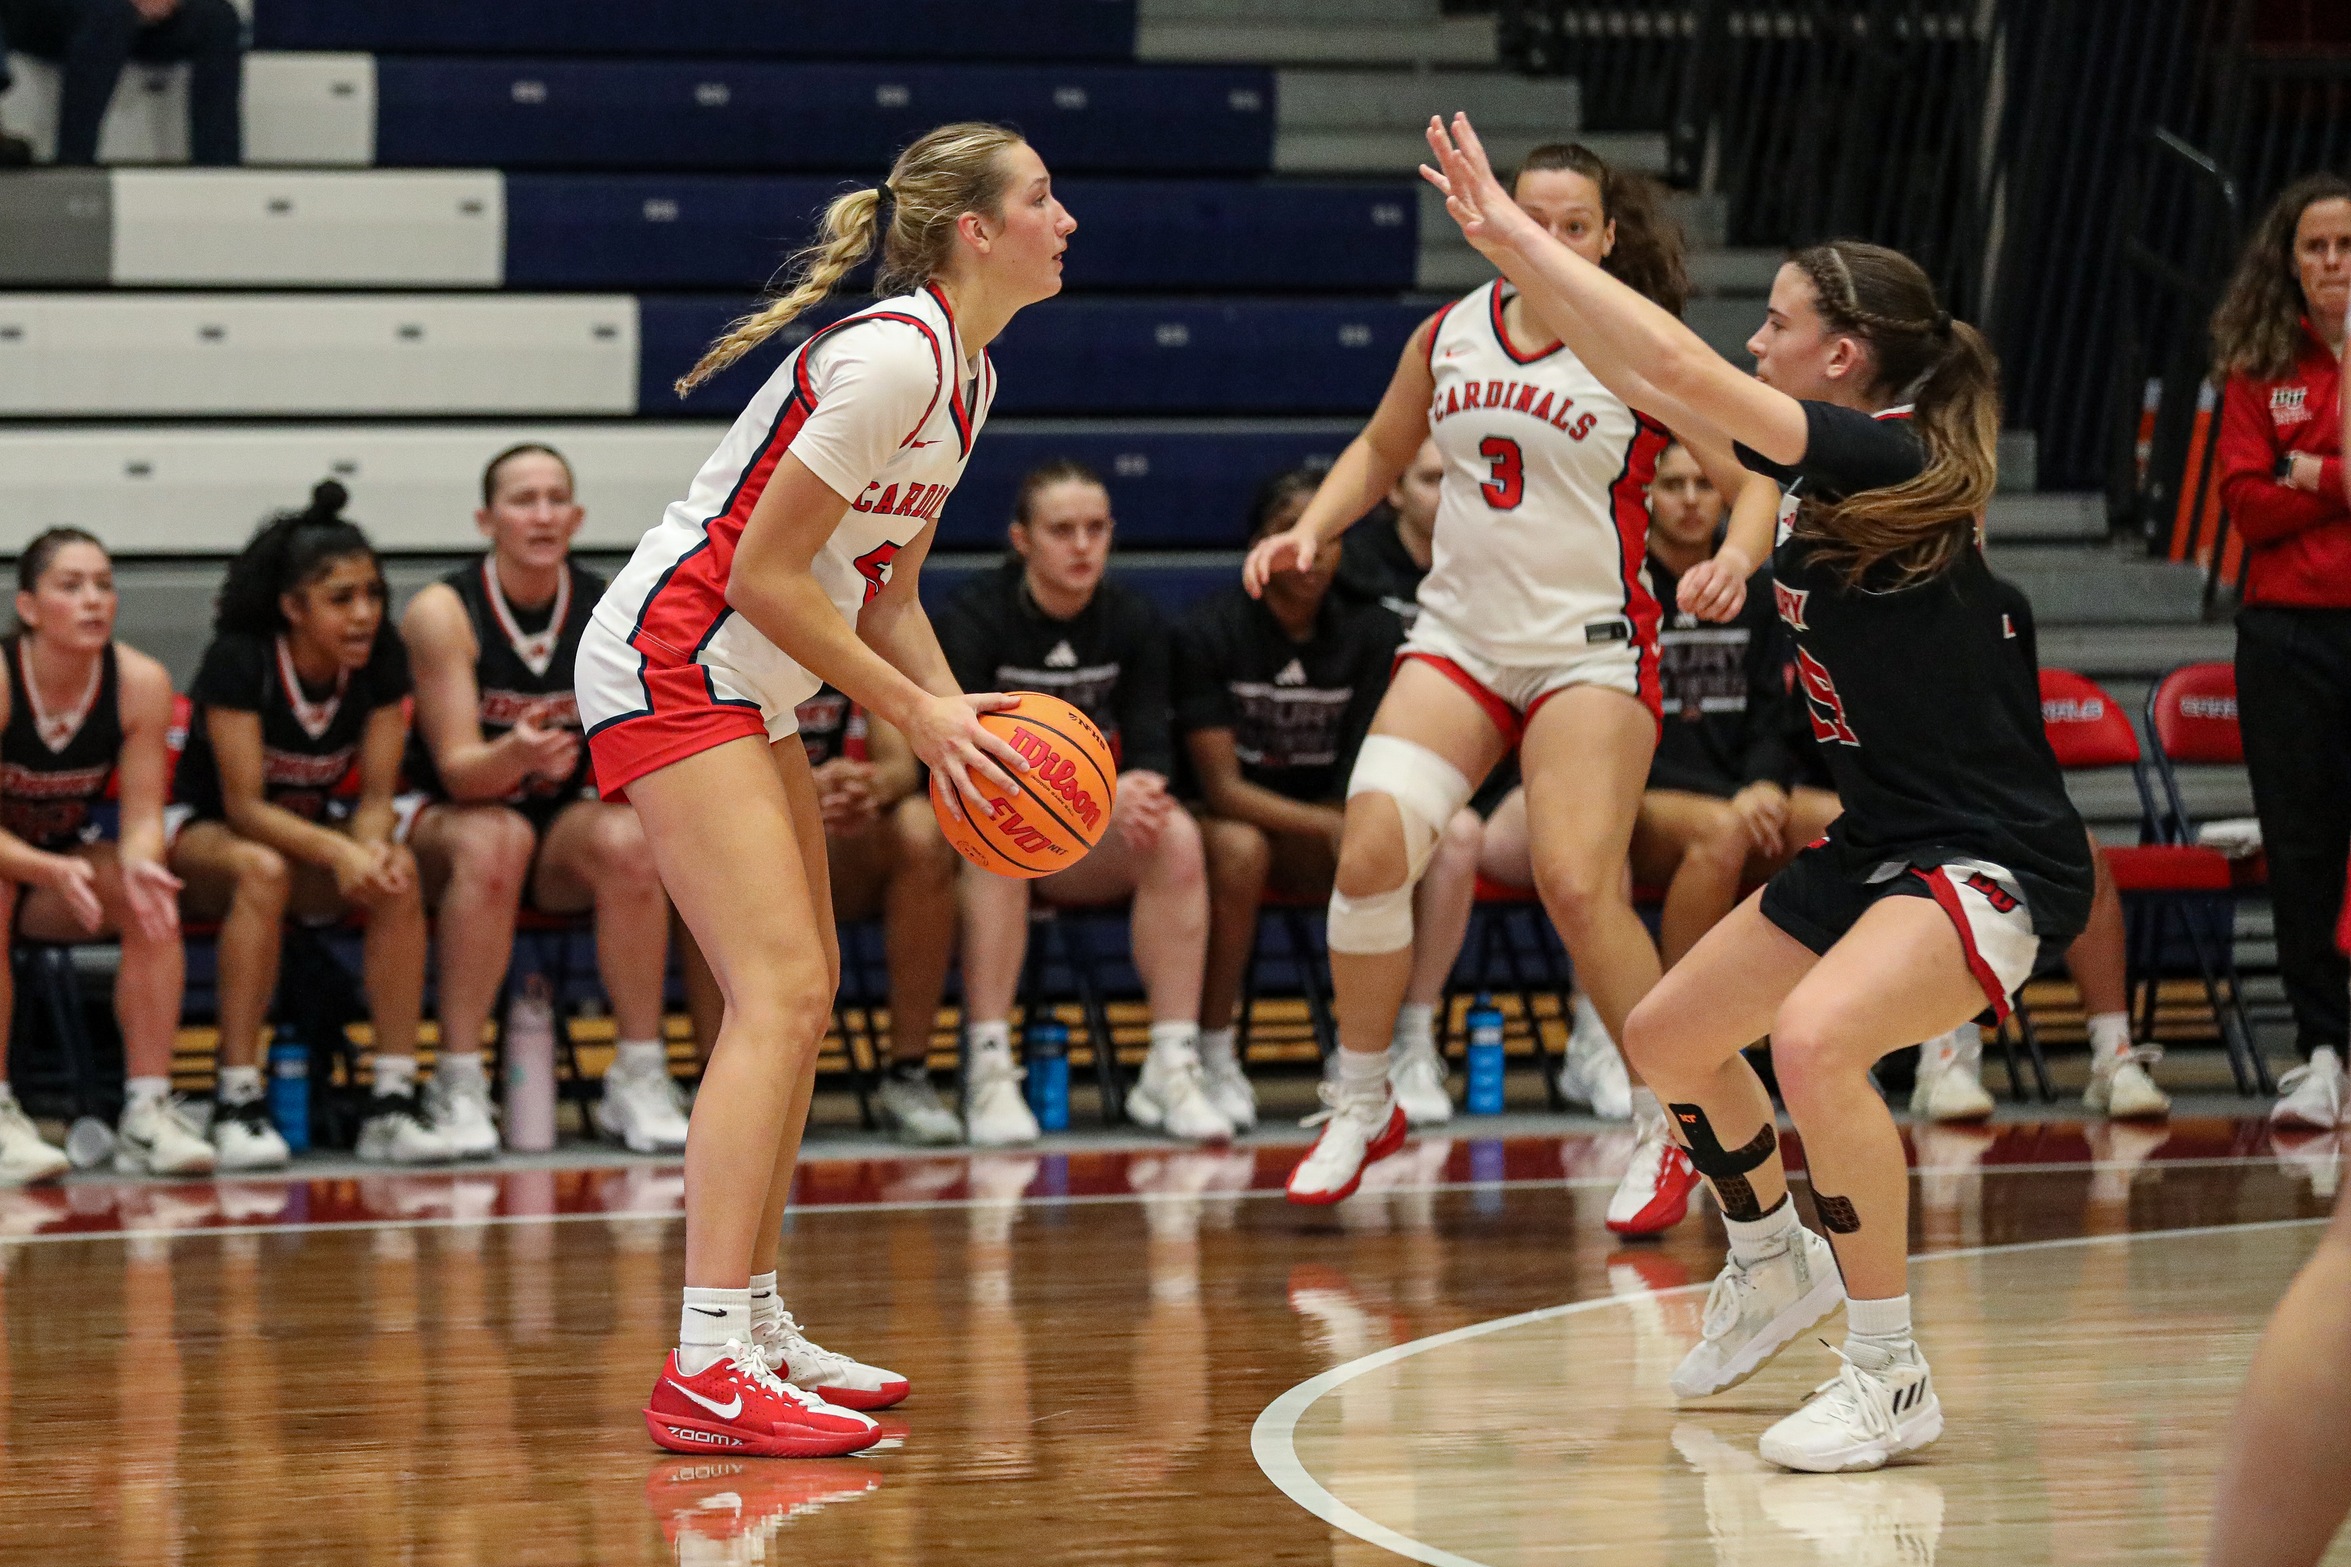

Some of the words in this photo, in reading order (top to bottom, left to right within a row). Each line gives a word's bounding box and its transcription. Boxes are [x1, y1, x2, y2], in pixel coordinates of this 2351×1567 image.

[1433, 381, 1598, 442] CARDINALS
[1479, 436, 1524, 510] 3
[1008, 725, 1102, 833] Wilson
[988, 796, 1053, 854] EVO
[1047, 842, 1069, 857] NXT
[1679, 1113, 1698, 1124] KT
